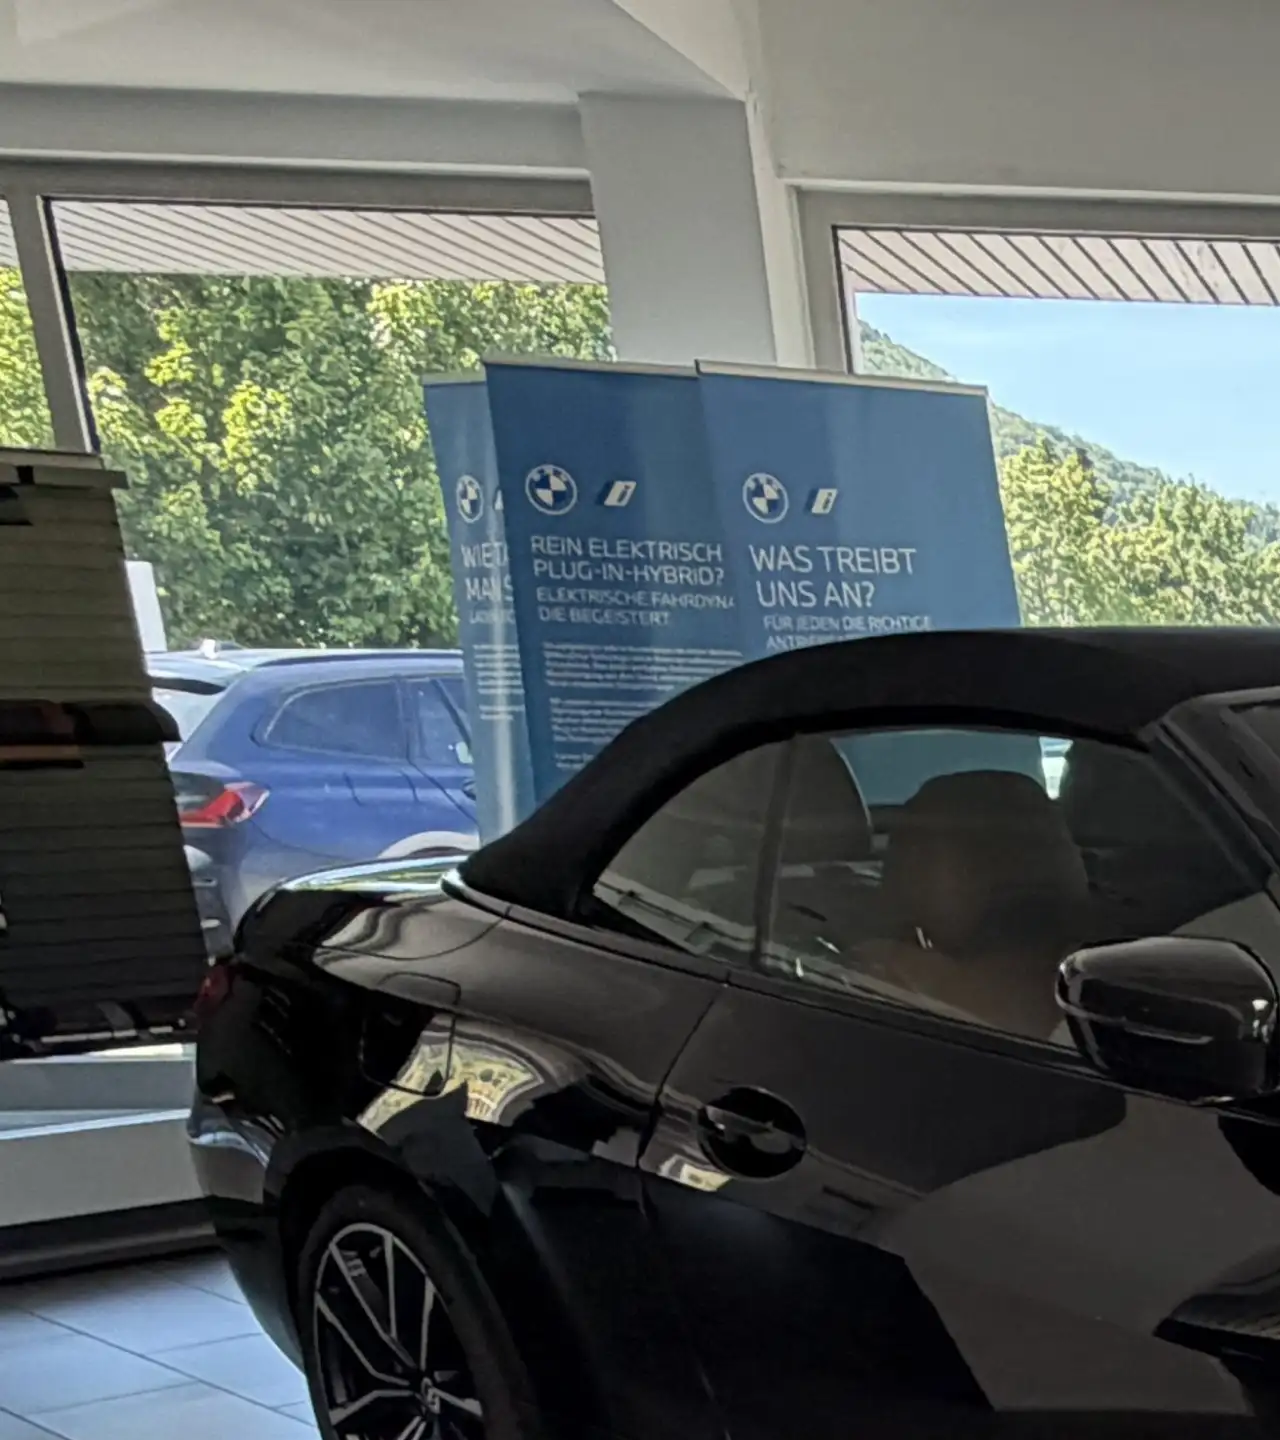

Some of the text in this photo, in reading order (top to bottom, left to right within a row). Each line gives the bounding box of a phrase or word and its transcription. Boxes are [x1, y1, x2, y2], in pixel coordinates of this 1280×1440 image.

[531, 536, 722, 563] REIN ELEKTRISCH
[748, 544, 917, 575] WAS TREIBT
[533, 559, 725, 586] PLUG-IN-HYBRID?
[536, 587, 649, 607] ELEKTRISCHE
[756, 580, 876, 608] UNS AN?
[539, 606, 670, 625] DIE BEGEISTERT
[763, 613, 793, 632] FÜR
[842, 615, 867, 632] DIE
